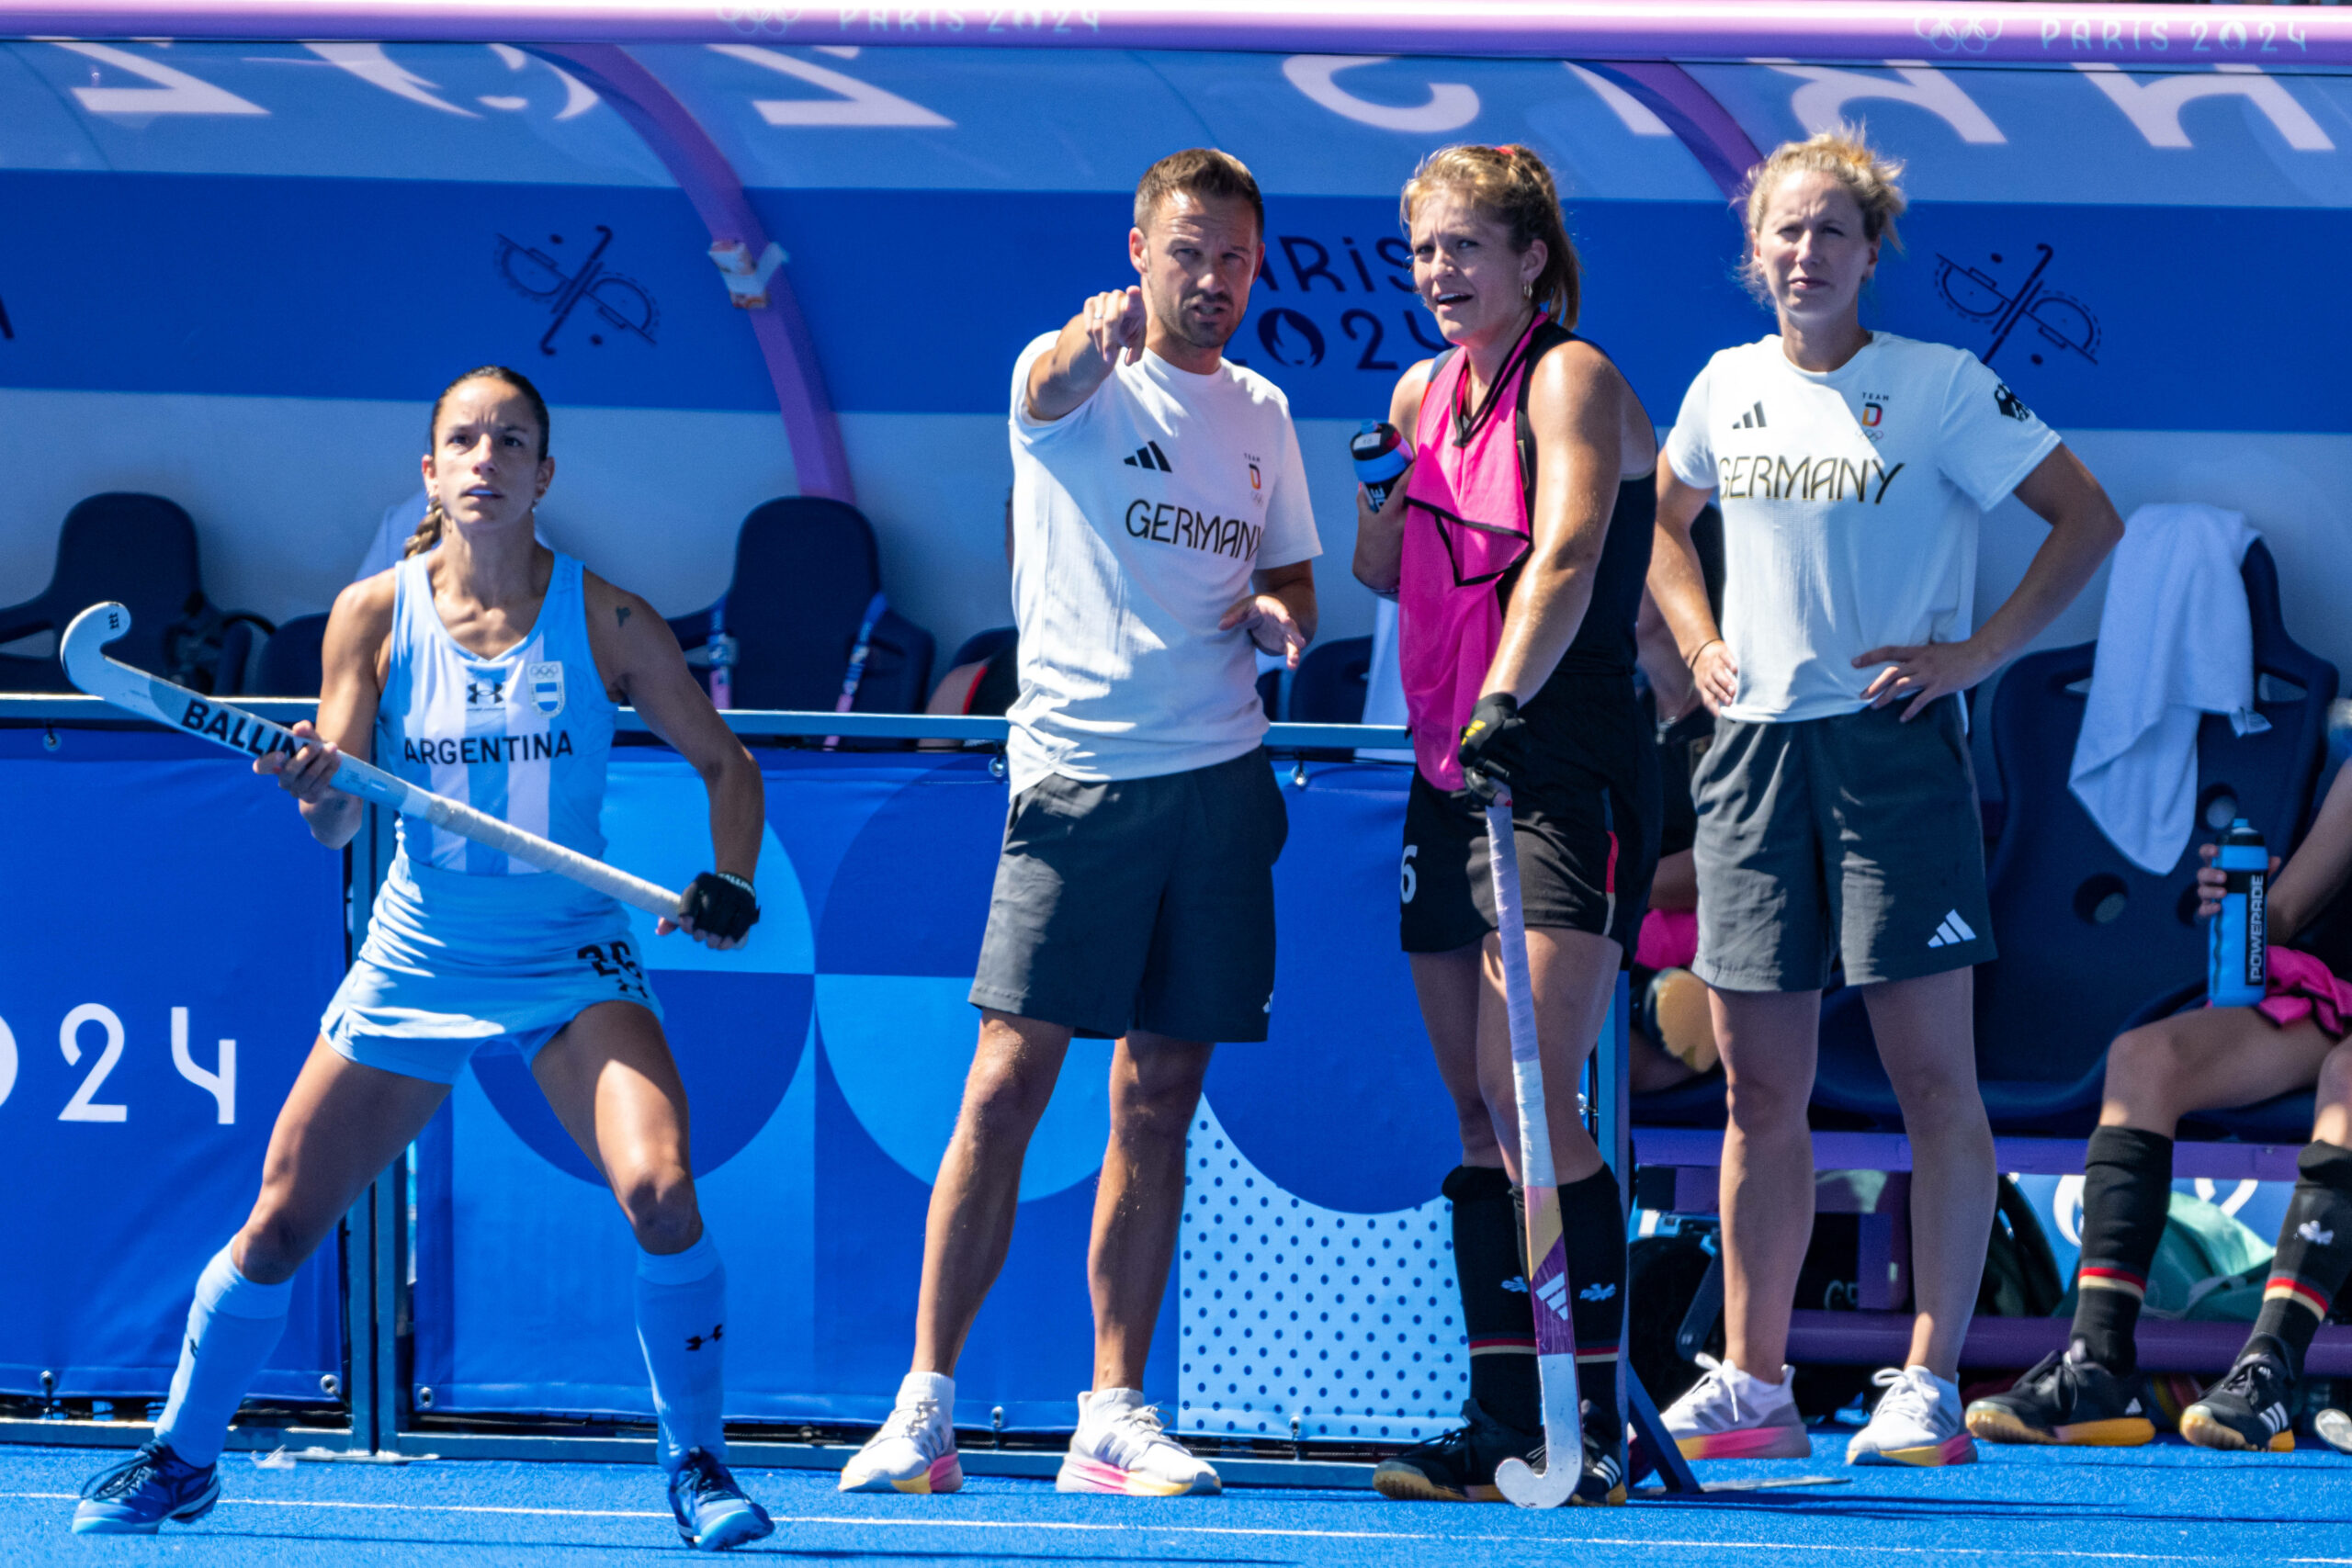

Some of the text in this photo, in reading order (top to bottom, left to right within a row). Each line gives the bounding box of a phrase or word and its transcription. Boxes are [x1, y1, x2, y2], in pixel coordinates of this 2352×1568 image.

[2041, 18, 2307, 52] PARIS 2024
[1862, 391, 1889, 401] TEAM
[1243, 452, 1261, 462] TEAM
[1720, 455, 1905, 505] GERMANY
[181, 698, 311, 759] BALLIN
[404, 730, 573, 765] ARGENTINA
[2250, 874, 2264, 980] POWERADE
[0, 1003, 236, 1124] 24
